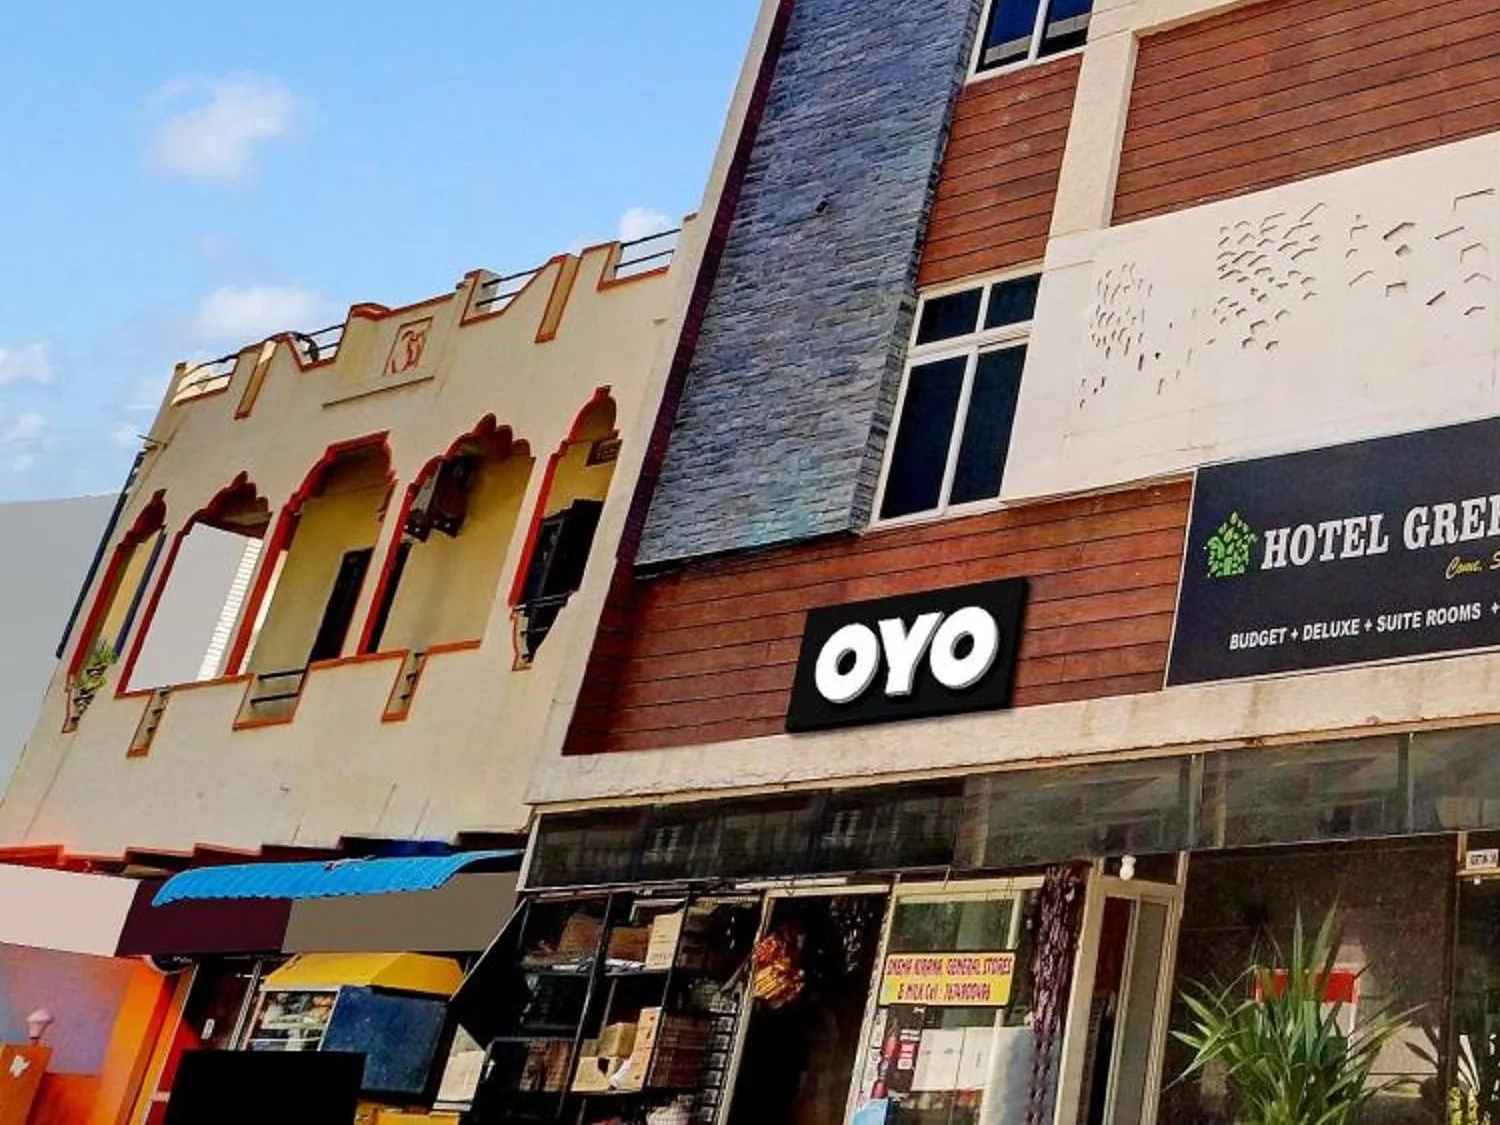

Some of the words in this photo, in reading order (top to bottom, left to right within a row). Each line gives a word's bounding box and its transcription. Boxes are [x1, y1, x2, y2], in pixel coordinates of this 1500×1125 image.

[1260, 513, 1389, 570] HOTEL
[815, 605, 999, 704] OYO
[1229, 627, 1288, 651] BUDGET
[1302, 618, 1360, 642] DELUXE
[1376, 610, 1422, 632] SUITE
[1425, 602, 1481, 627] ROOMS
